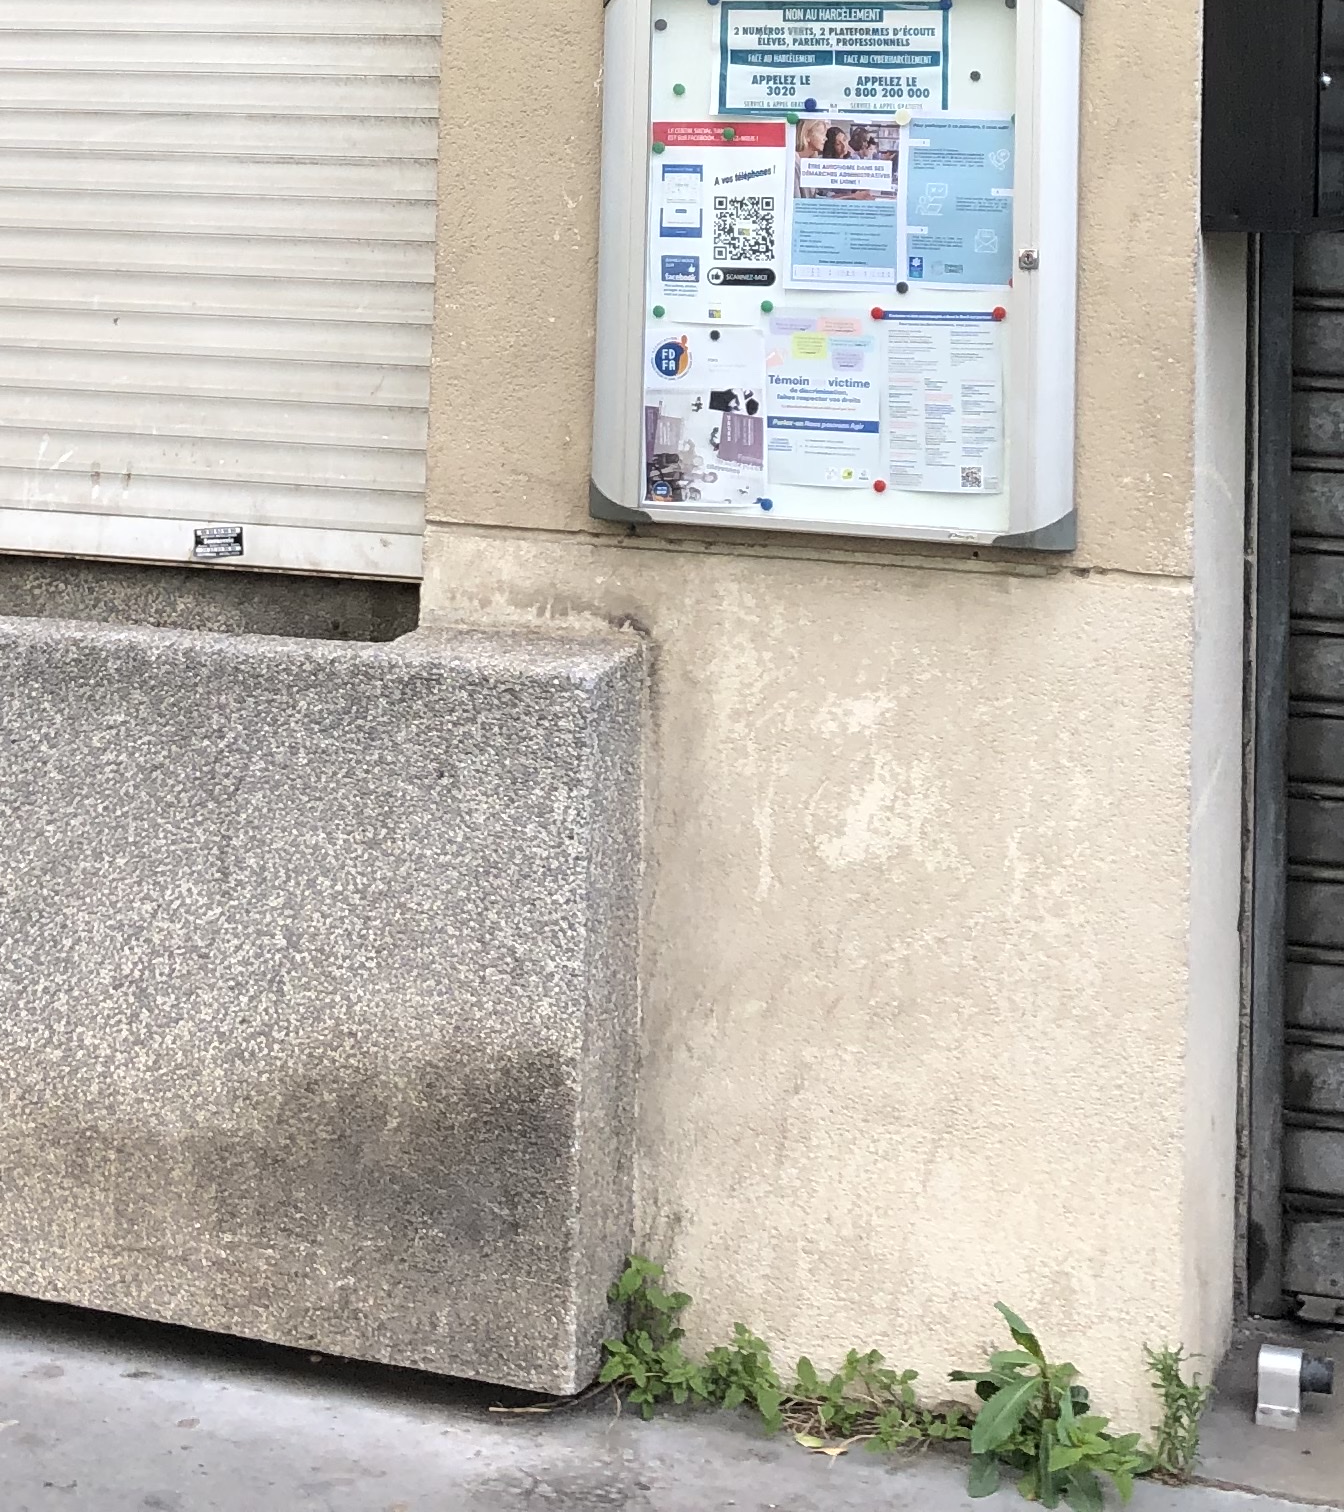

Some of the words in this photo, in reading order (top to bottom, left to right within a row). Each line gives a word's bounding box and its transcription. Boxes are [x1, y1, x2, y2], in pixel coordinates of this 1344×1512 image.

[785, 9, 805, 21] NON
[807, 9, 818, 21] AU
[819, 7, 881, 21] HARCÈLEMENT
[734, 27, 740, 36] 2
[742, 25, 785, 36] NUMÉROS
[819, 27, 826, 36] 2
[828, 27, 889, 36] PLATEFORMES
[757, 35, 789, 47] ÉLÈVES,
[792, 37, 833, 48] PARENTS,
[836, 38, 910, 47] PROFESSIONNELS
[751, 74, 796, 85] APPELEZ
[799, 75, 811, 86] LE
[856, 76, 902, 86] APPELEZ
[905, 77, 918, 87] LE
[766, 86, 796, 96] 3020
[844, 87, 851, 97] 0
[855, 88, 877, 98] 800
[881, 88, 904, 98] 200
[907, 88, 930, 98] 000
[662, 349, 675, 359] FD
[662, 360, 675, 371] FA
[768, 375, 810, 386] Témoin
[828, 377, 871, 388] victime
